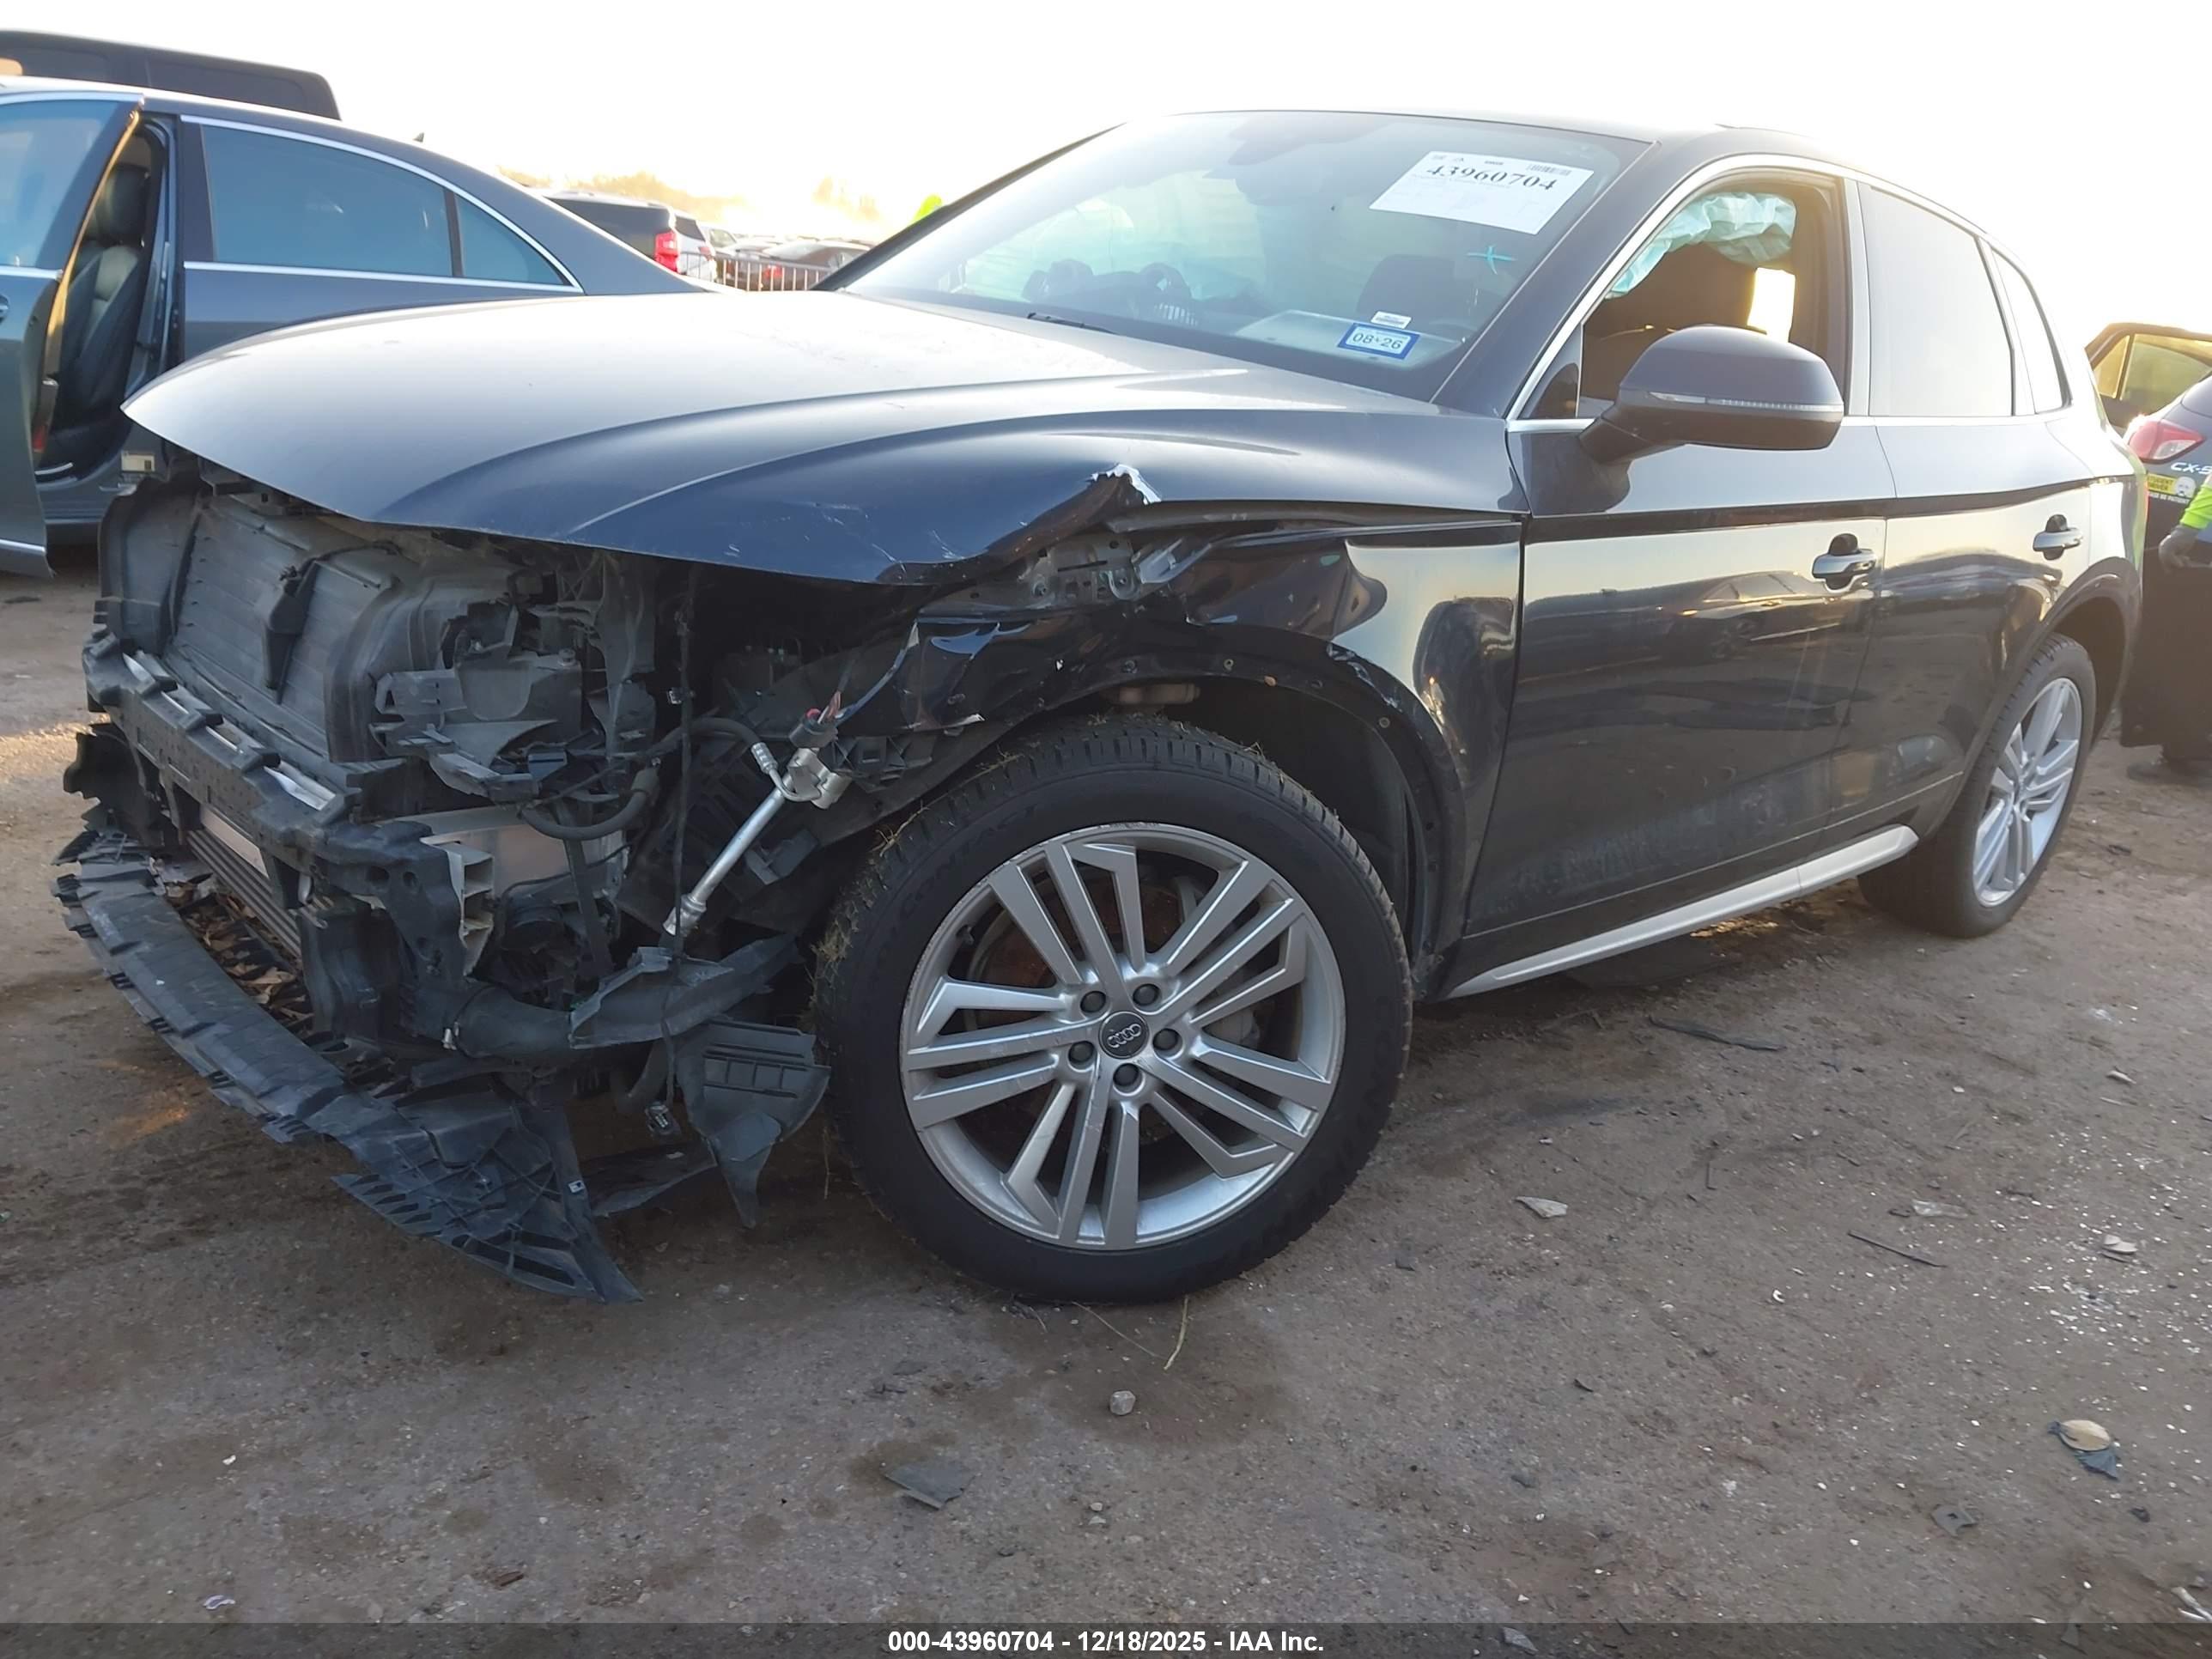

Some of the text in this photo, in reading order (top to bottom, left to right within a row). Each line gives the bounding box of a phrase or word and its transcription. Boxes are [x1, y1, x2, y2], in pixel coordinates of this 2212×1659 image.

[1426, 164, 1558, 191] 43960704
[1352, 332, 1403, 349] 08 26
